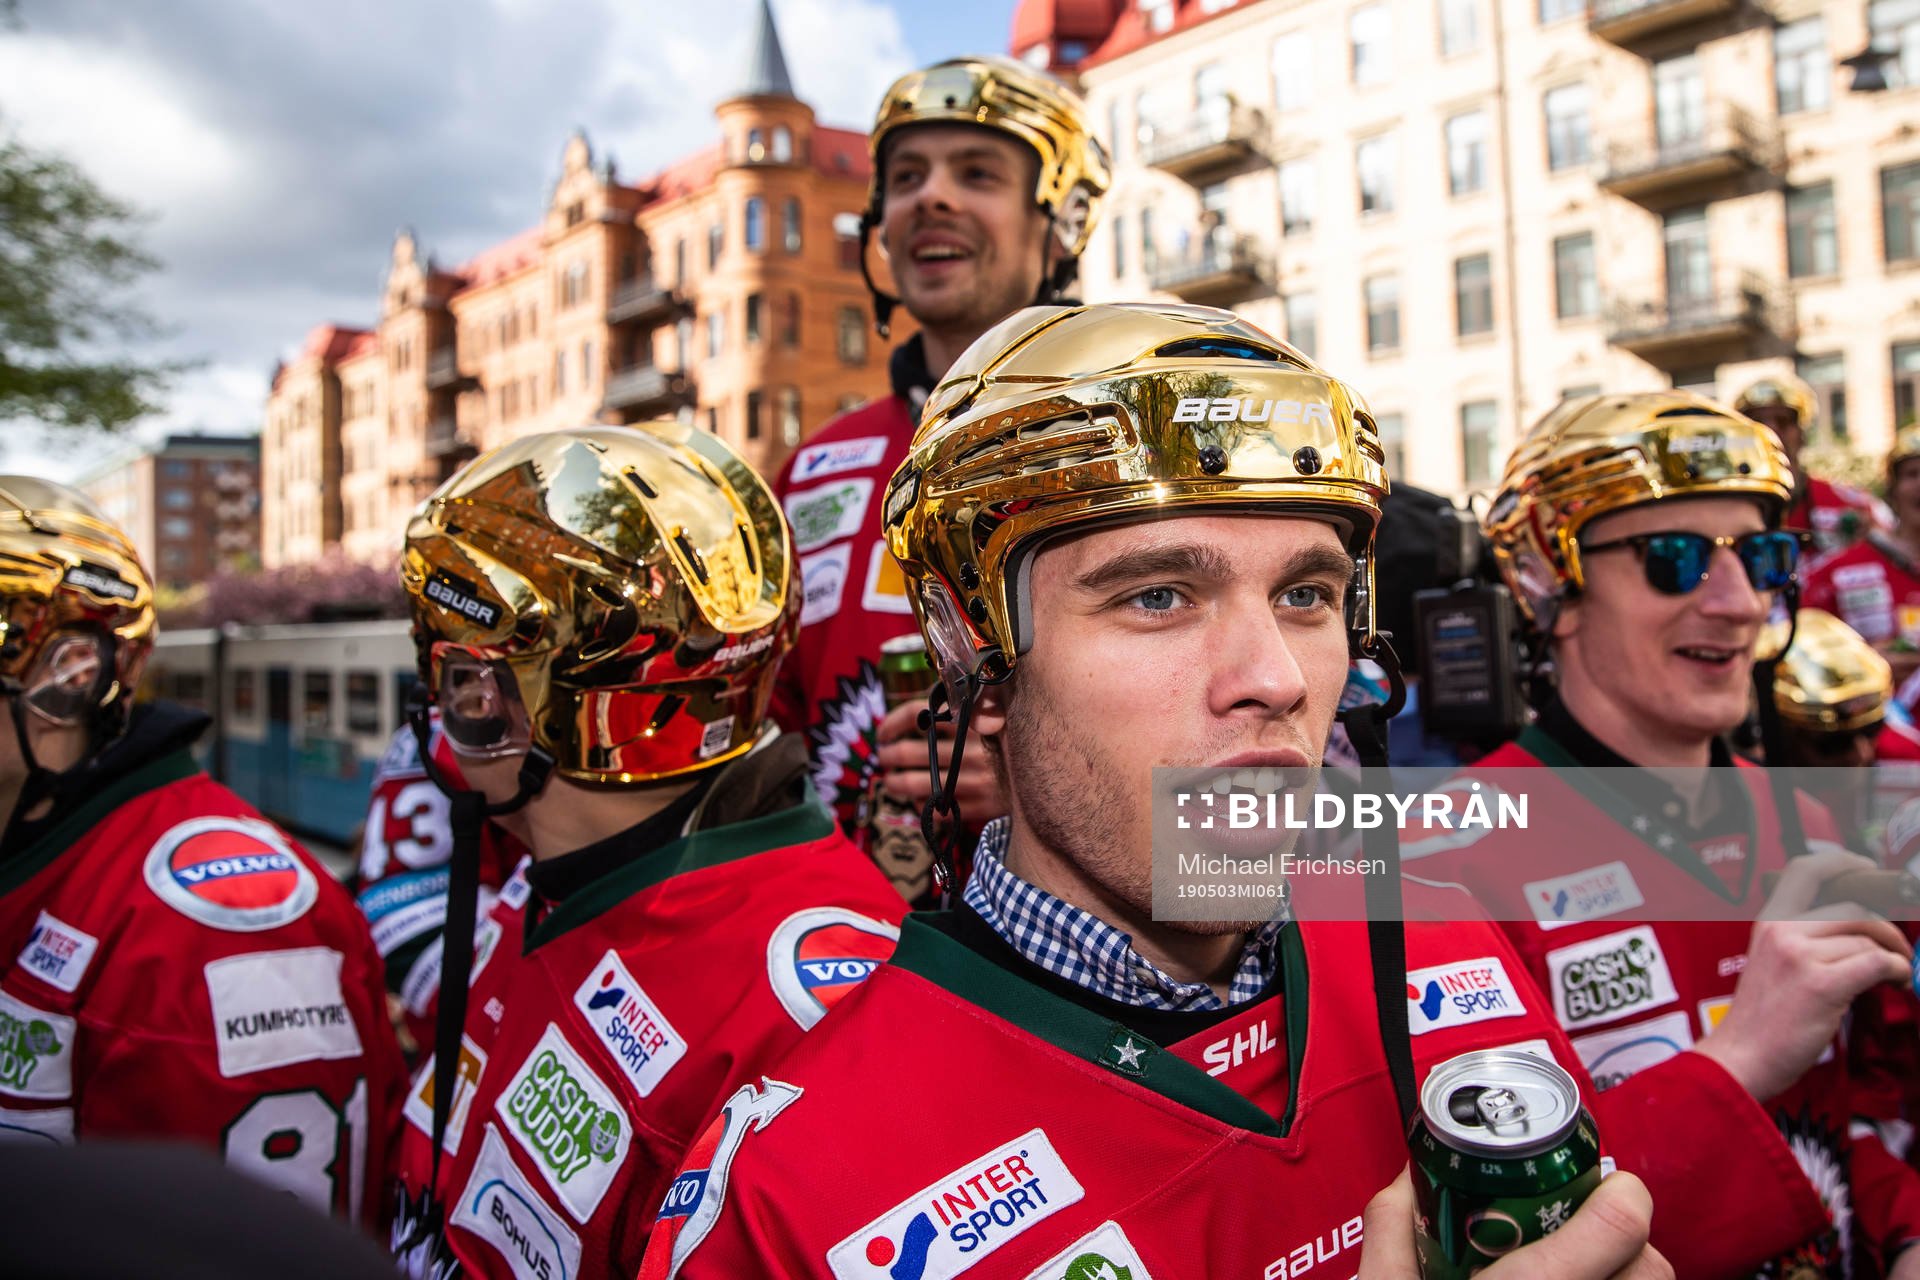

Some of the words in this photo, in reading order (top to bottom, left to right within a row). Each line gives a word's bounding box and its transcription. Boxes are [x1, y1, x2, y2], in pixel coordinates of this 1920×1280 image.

[177, 855, 290, 882] VOLVO
[1439, 970, 1498, 995] INTER
[1564, 949, 1630, 992] CASH
[1567, 974, 1653, 1019] BUDDY
[618, 995, 666, 1056] INTER
[1453, 989, 1508, 1015] SPORT
[606, 1016, 651, 1075] SPORT
[1202, 1019, 1278, 1078] SHL
[533, 1054, 594, 1136] CASH
[511, 1079, 589, 1180] BUDDY
[931, 1154, 1035, 1227] INTER
[950, 1177, 1049, 1254] SPORT
[491, 1195, 552, 1280] BOHUS
